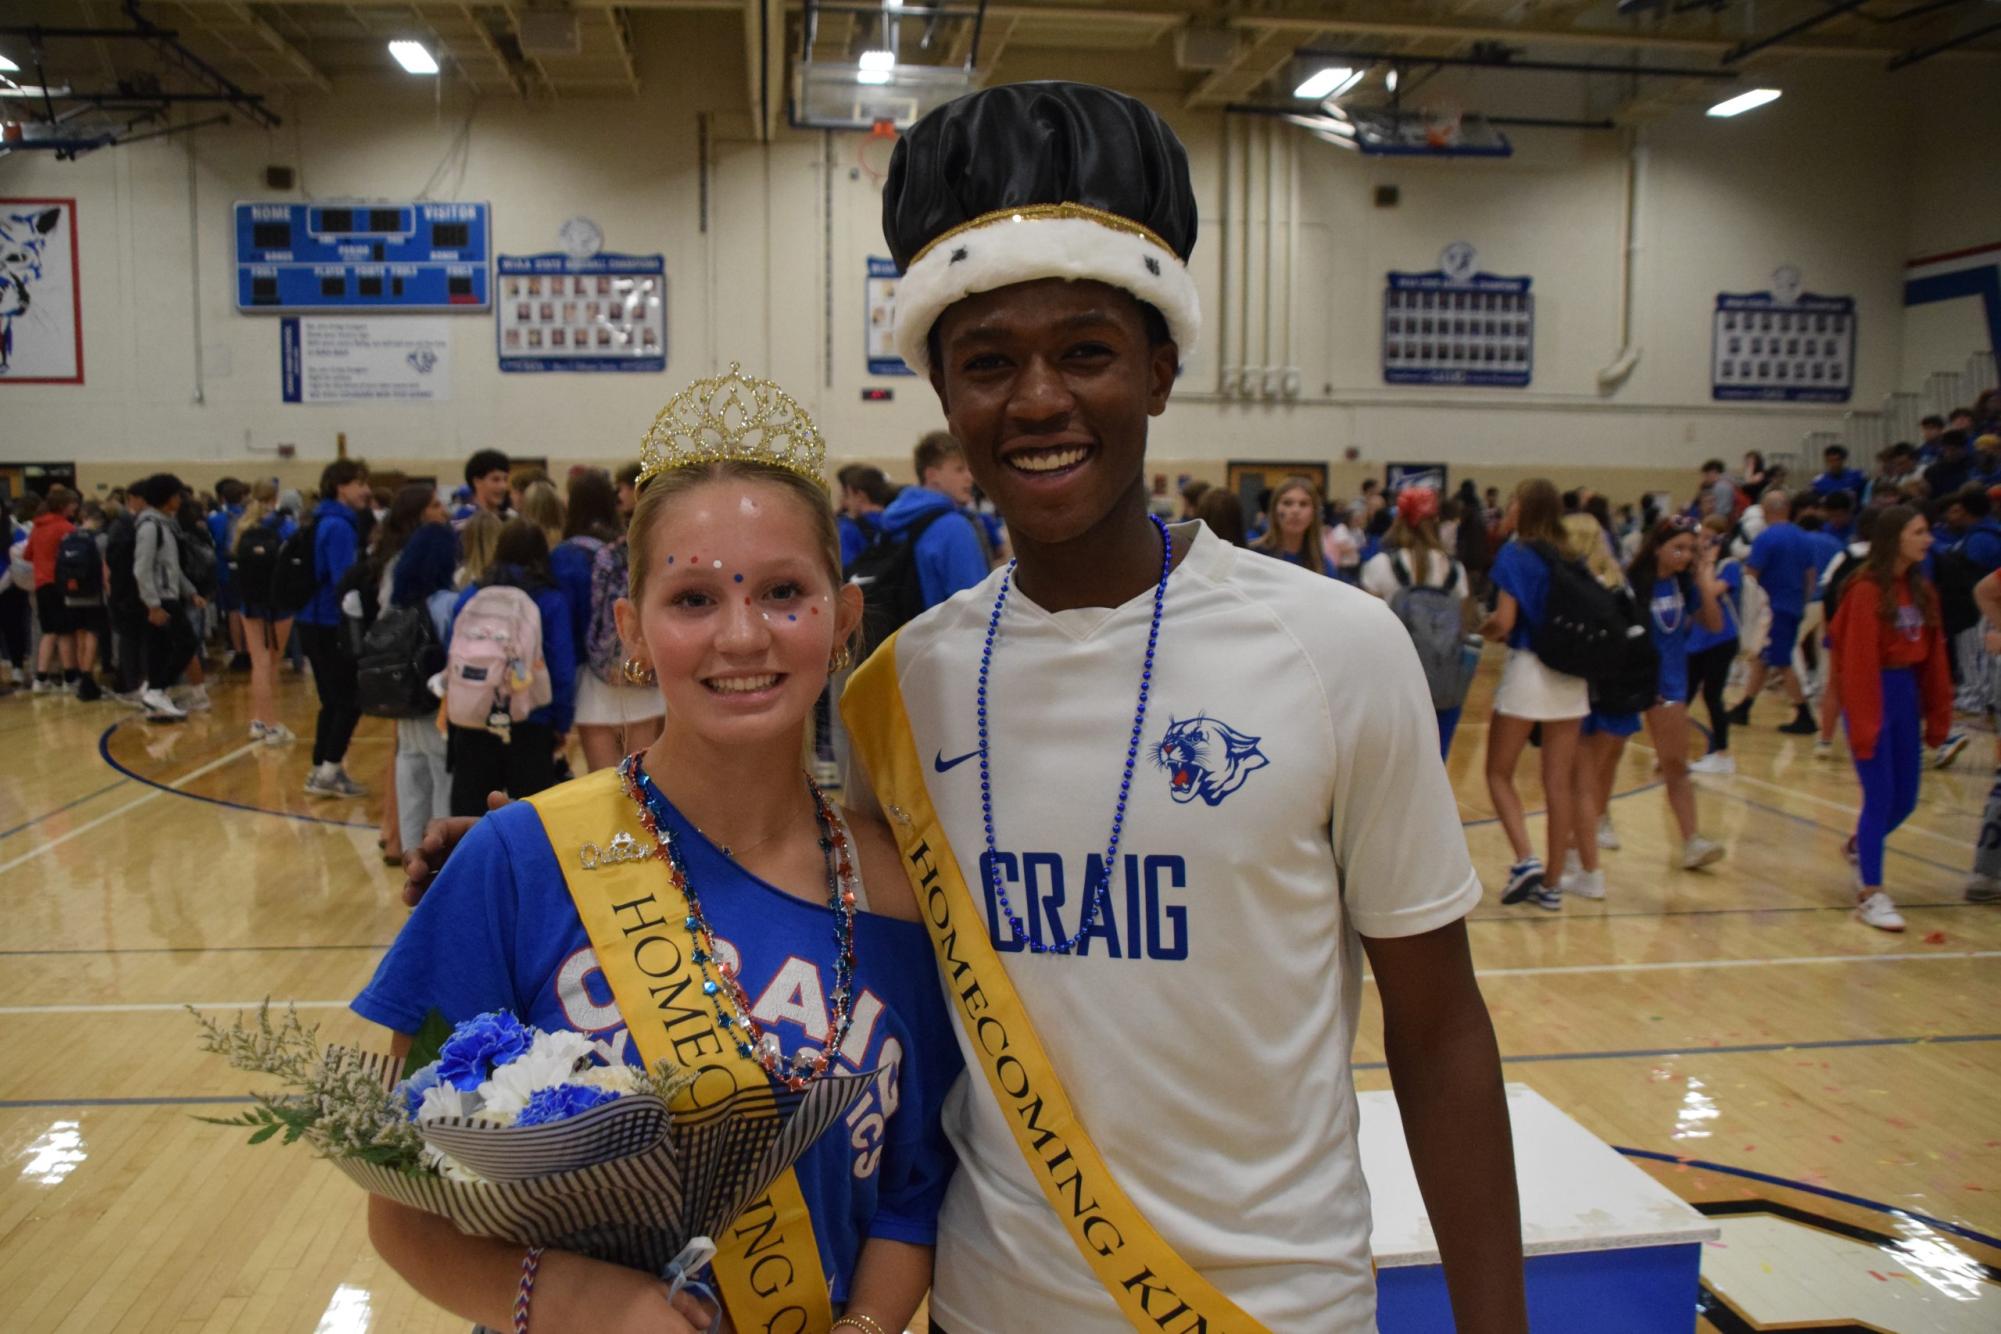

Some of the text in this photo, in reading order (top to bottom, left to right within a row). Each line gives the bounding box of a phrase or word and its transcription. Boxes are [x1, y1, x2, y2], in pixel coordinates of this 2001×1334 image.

[251, 204, 291, 220] HOME
[424, 204, 477, 221] VISITOR
[979, 851, 1188, 961] CRAIG
[909, 838, 1125, 1257] HOMECOMING
